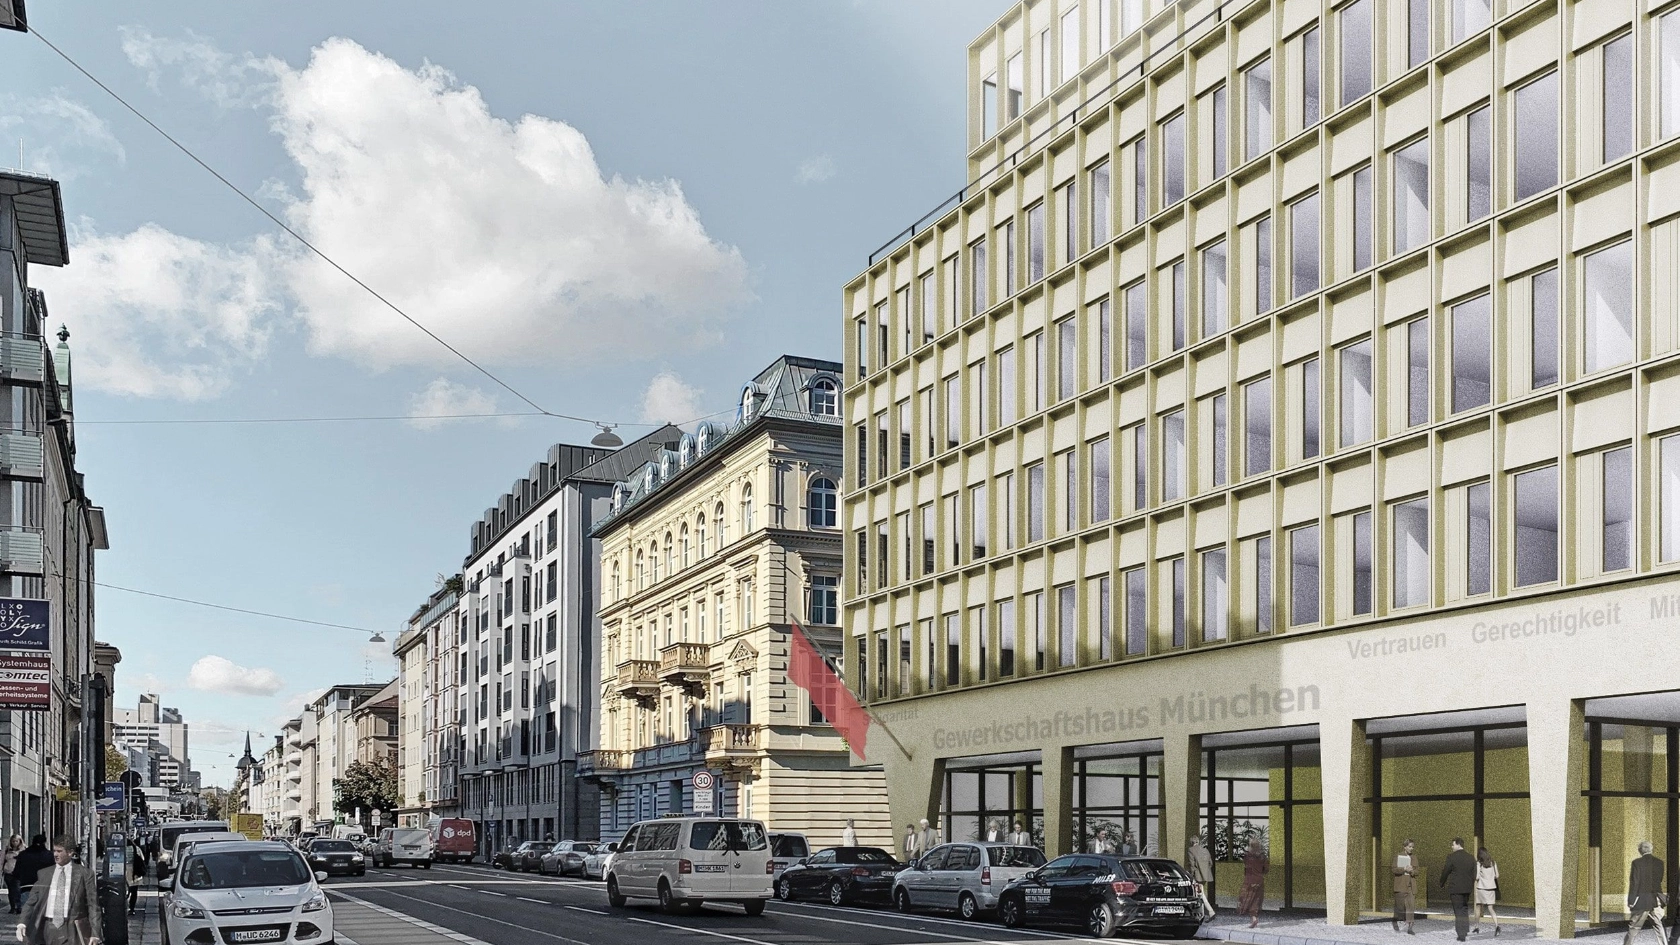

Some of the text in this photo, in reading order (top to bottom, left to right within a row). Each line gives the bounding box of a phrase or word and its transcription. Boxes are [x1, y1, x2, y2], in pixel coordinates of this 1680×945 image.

[1347, 632, 1447, 660] Vertrauen
[1471, 602, 1621, 644] Gerechtigkeit
[0, 660, 48, 668] ystemhaus
[933, 683, 1320, 749] Gewerkschaftshaus München
[697, 776, 709, 785] 30
[259, 930, 279, 938] 6246
